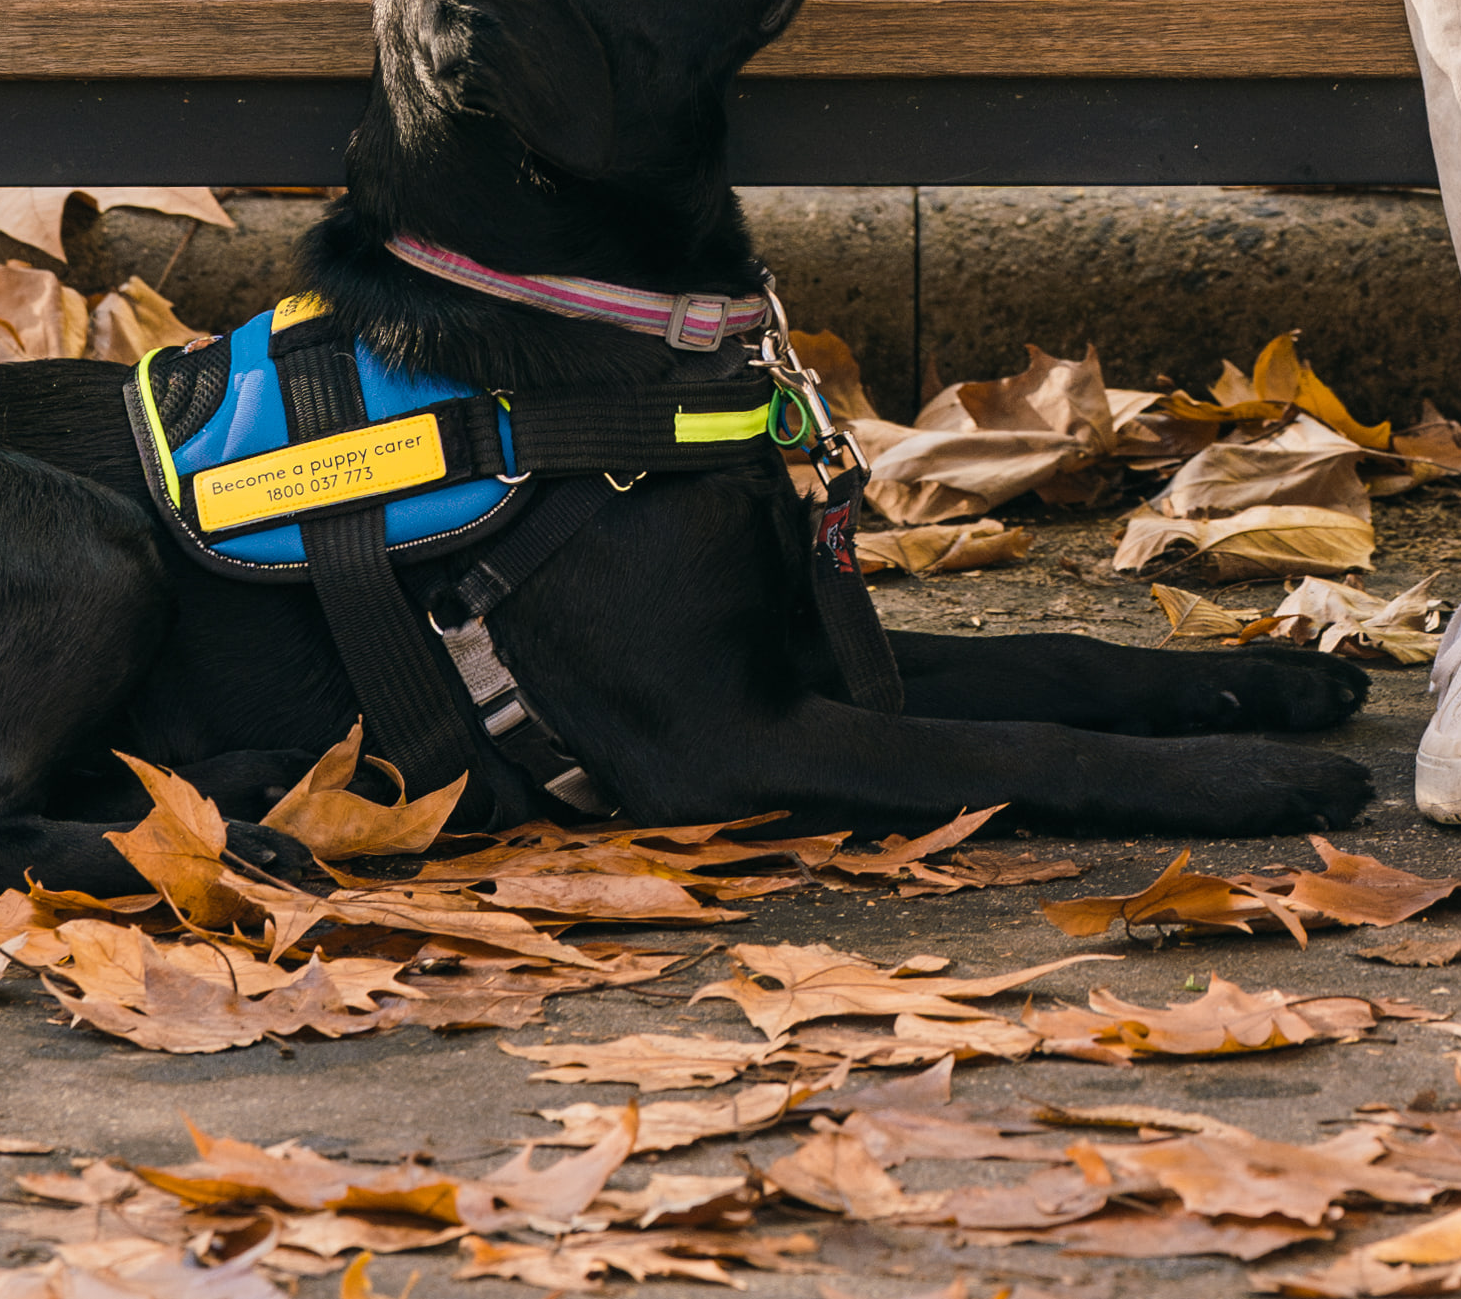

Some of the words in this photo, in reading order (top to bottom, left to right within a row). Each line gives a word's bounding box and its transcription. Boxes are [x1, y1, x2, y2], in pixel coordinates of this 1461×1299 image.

[212, 468, 287, 495] Become
[292, 465, 303, 475] a
[310, 448, 368, 476] puppy
[374, 435, 422, 456] carer
[266, 482, 305, 502] 1800
[310, 474, 338, 493] 037
[344, 466, 374, 485] 773
